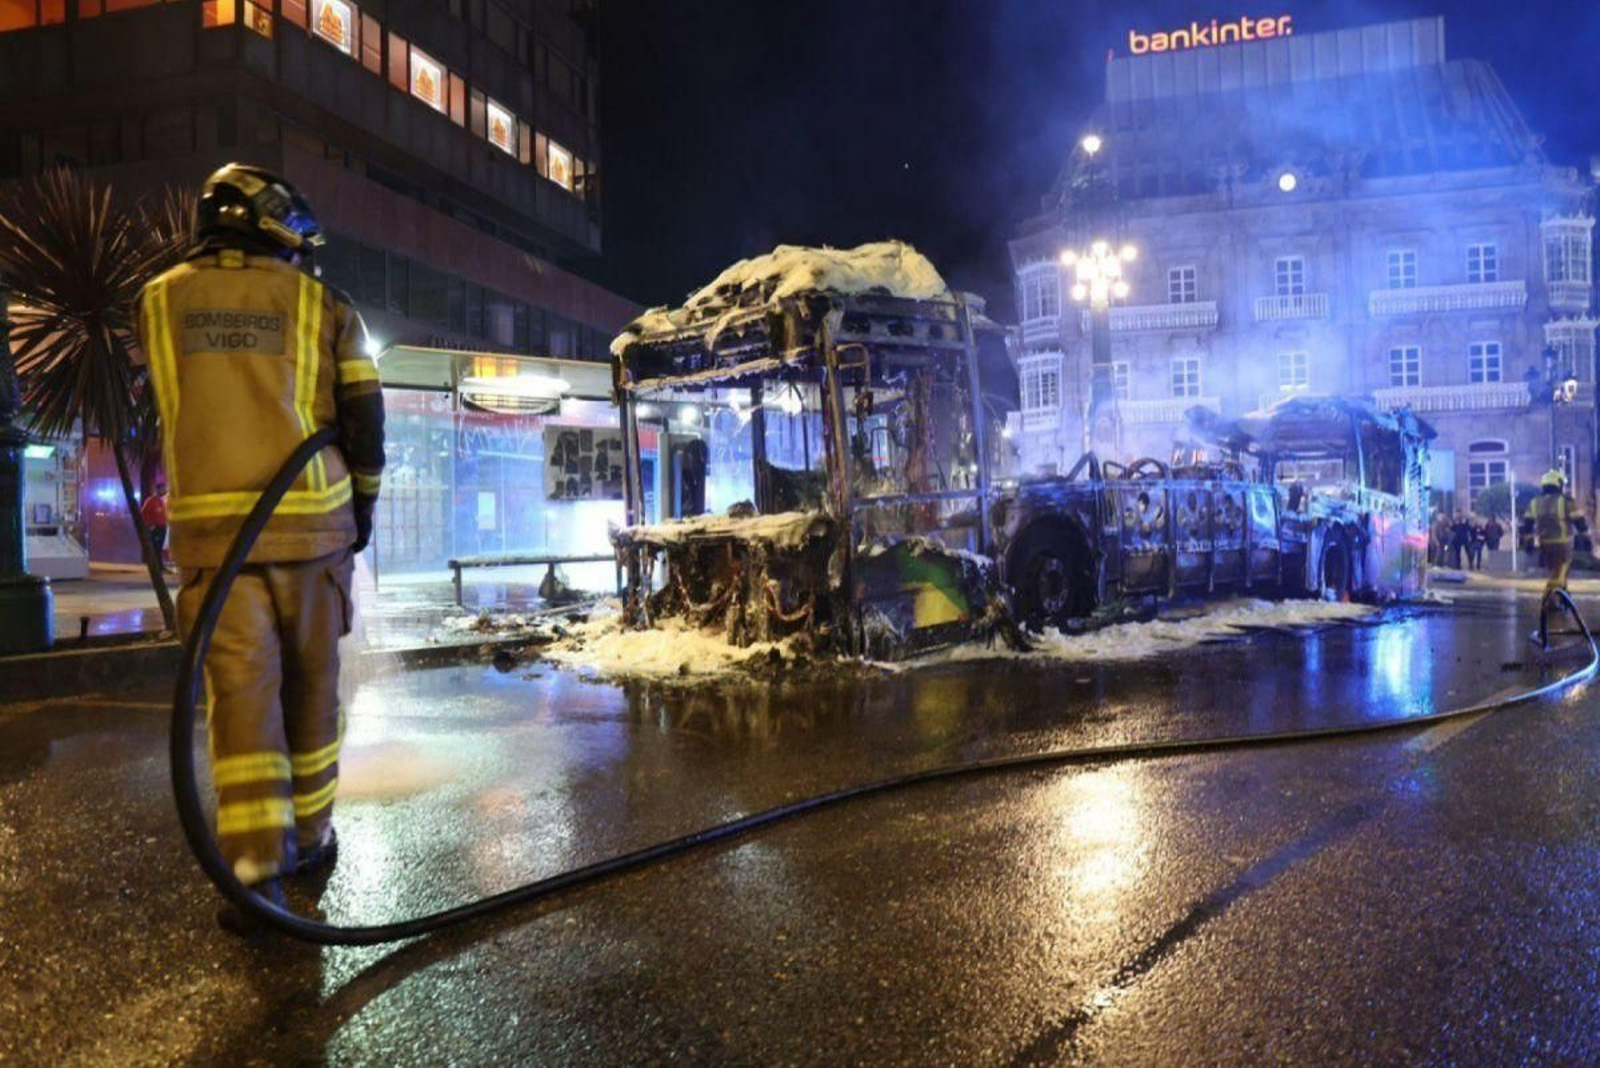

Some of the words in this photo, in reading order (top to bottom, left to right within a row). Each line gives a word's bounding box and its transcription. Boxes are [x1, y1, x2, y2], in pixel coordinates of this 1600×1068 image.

[1129, 15, 1292, 54] bankinter.
[184, 312, 280, 331] BOMBEIROS
[206, 332, 257, 348] VIGO
